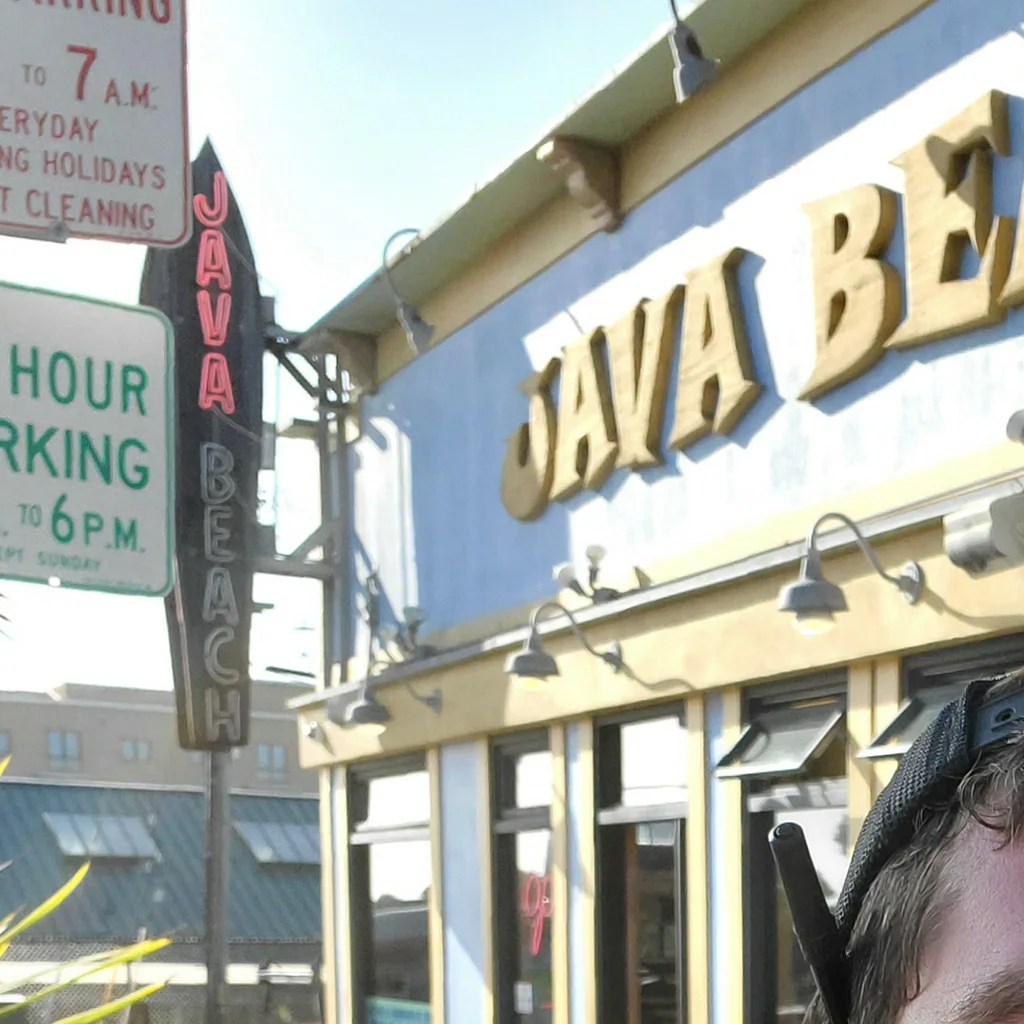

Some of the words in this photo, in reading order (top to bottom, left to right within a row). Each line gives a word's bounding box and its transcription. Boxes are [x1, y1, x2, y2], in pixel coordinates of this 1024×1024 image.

[22, 63, 46, 86] TO
[67, 44, 97, 101] 7
[0, 106, 98, 143] ERYDAY
[44, 150, 165, 190] HOLIDAYS
[26, 189, 156, 230] CLEANING
[194, 171, 235, 414] JAVA
[10, 344, 148, 416] HOUR
[501, 246, 764, 522] JAVA
[0, 418, 150, 490] RKING
[18, 503, 43, 527] TO
[200, 442, 240, 742] BEACH
